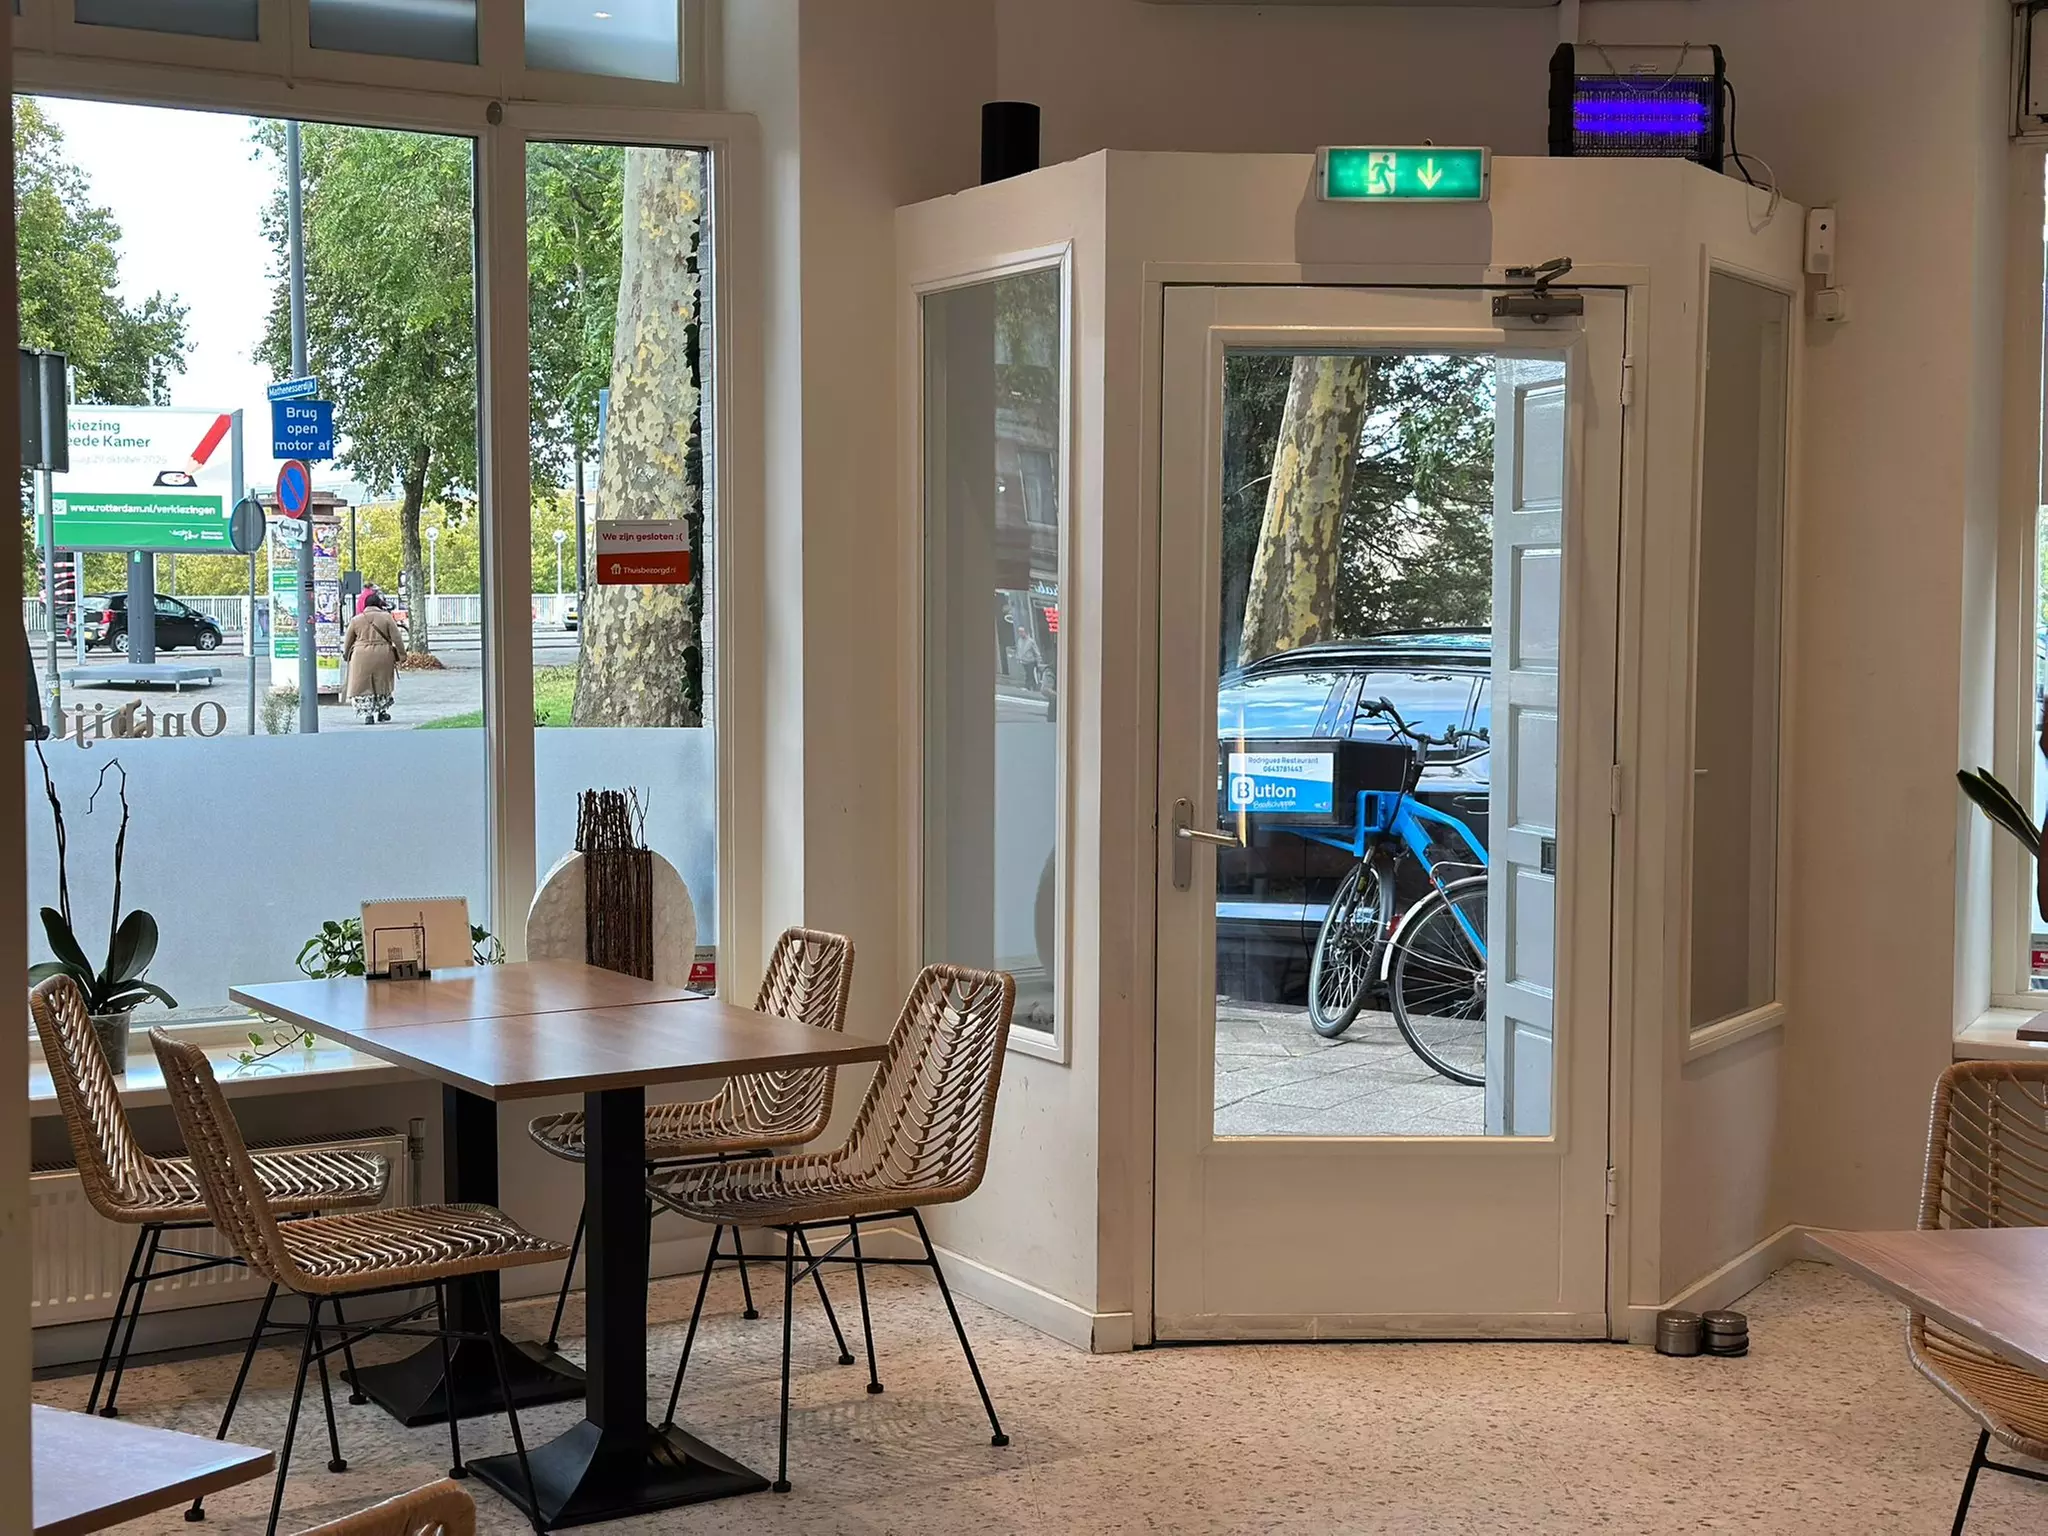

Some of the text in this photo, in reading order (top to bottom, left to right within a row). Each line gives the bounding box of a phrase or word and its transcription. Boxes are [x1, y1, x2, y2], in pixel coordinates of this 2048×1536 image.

[286, 407, 317, 421] Brug
[68, 419, 120, 434] kiezing
[287, 425, 318, 436] open
[103, 435, 151, 447] Kamer
[275, 440, 331, 451] motor af
[70, 504, 216, 515] www.rotterdam.nl/verkiezingen
[619, 533, 634, 541] zijn
[636, 533, 674, 542] gesloten
[1248, 757, 1280, 765] Rodrigues
[396, 963, 414, 977] 11
